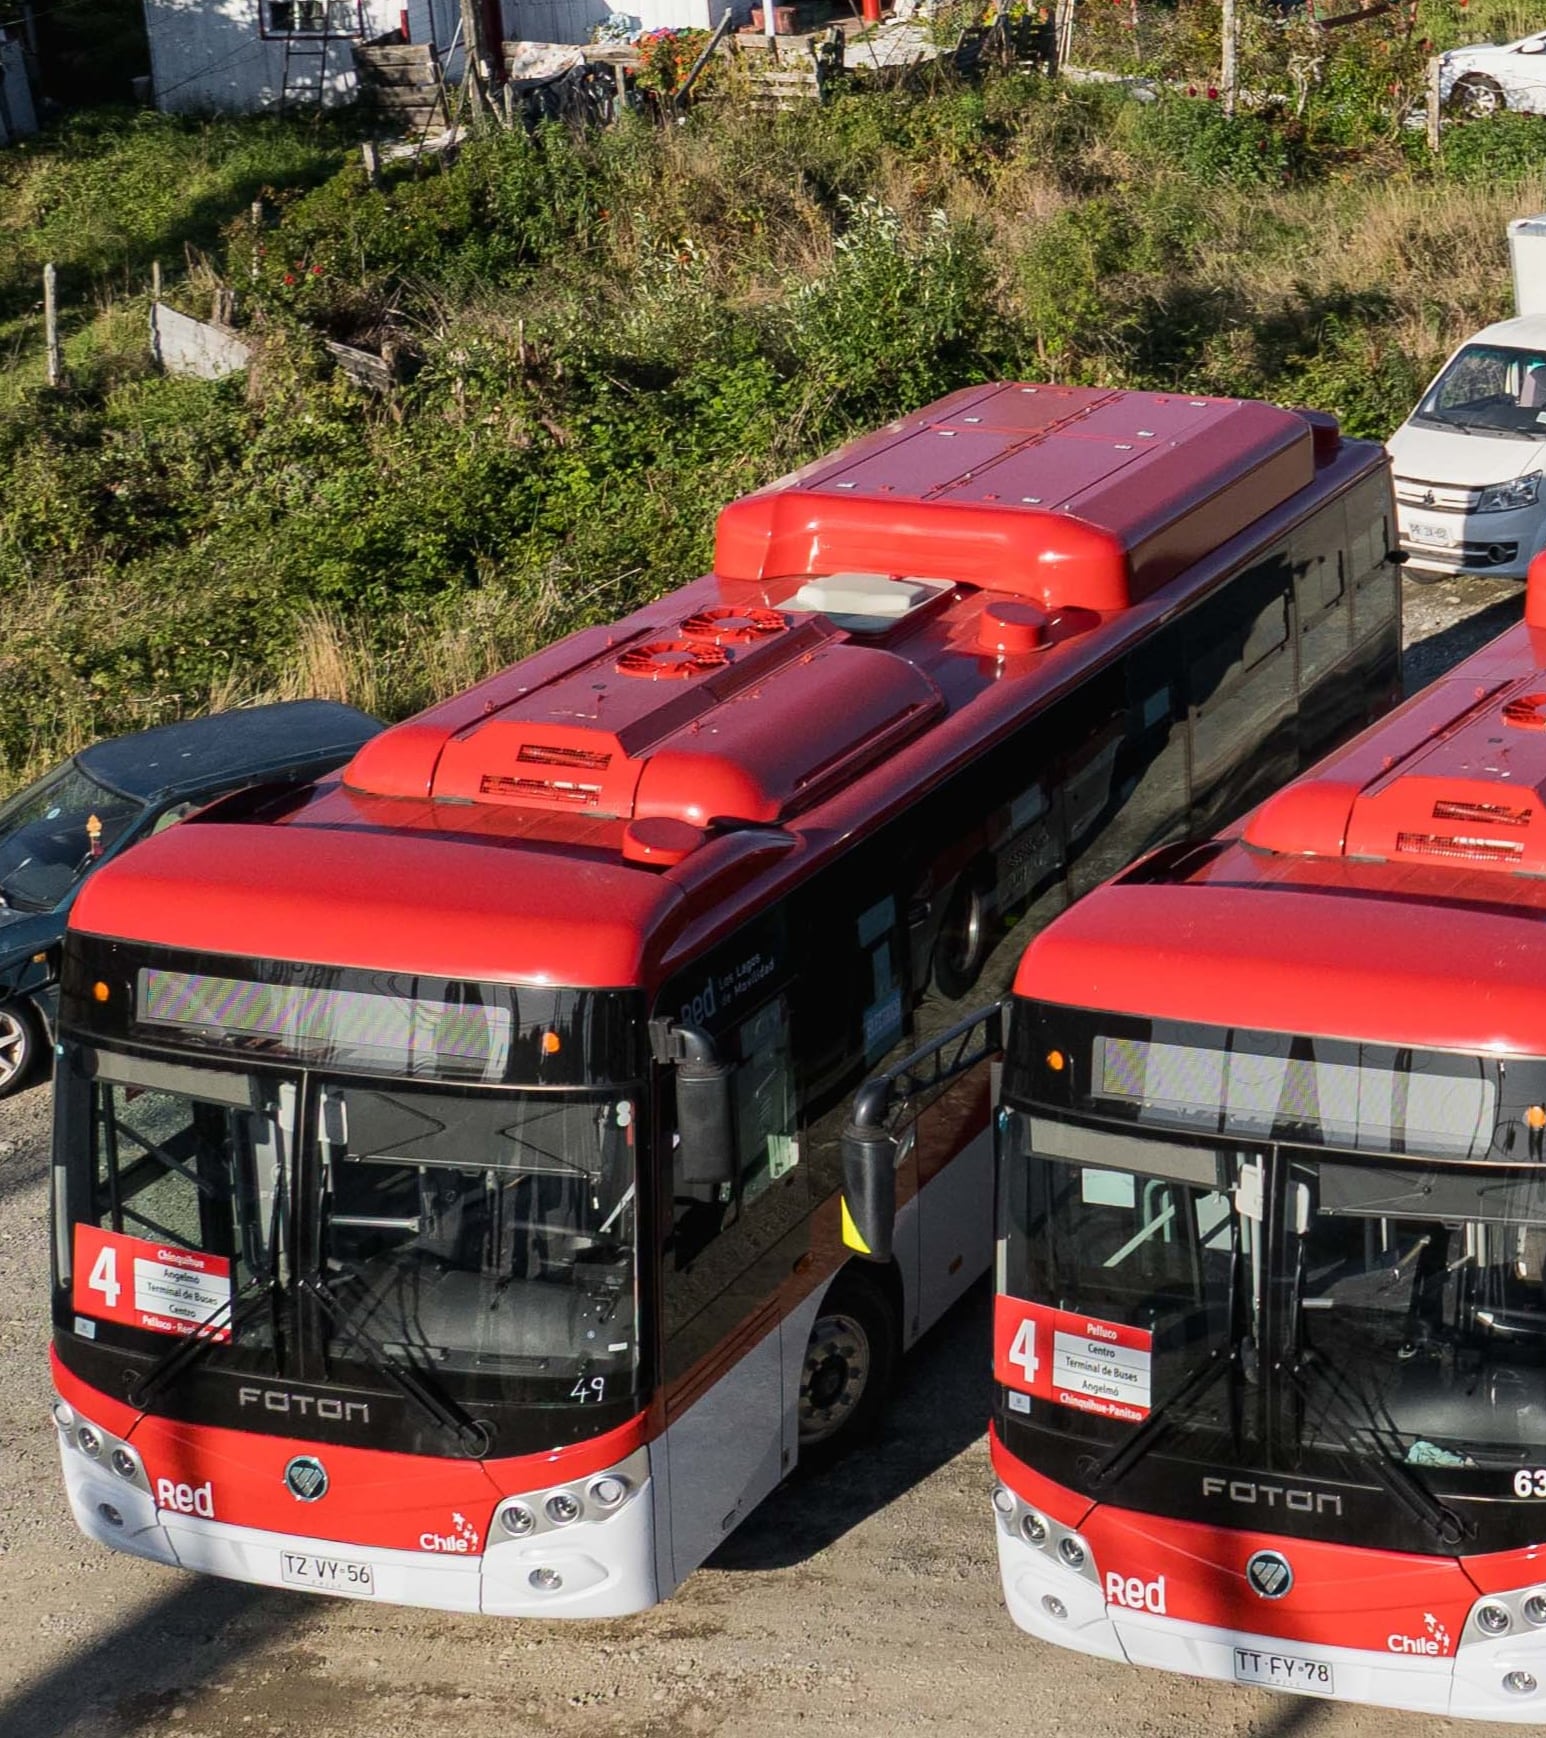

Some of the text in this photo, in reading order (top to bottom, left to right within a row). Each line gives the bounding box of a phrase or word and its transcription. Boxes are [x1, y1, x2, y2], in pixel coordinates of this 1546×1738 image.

[88, 1246, 121, 1307] 4
[147, 1281, 218, 1306] Terminal de Buses
[168, 1304, 197, 1318] Centro
[1087, 1323, 1117, 1341] Pelluco
[1009, 1318, 1039, 1383] 4
[1088, 1343, 1116, 1359] Centro
[1066, 1356, 1138, 1383] Terminal de Buses
[570, 1377, 605, 1404] 49
[238, 1387, 370, 1423] FOTON
[157, 1478, 214, 1518] Red
[1203, 1477, 1342, 1516] FOTON
[420, 1533, 468, 1552] Chile
[1106, 1571, 1166, 1615] Red
[1387, 1634, 1439, 1655] Chile
